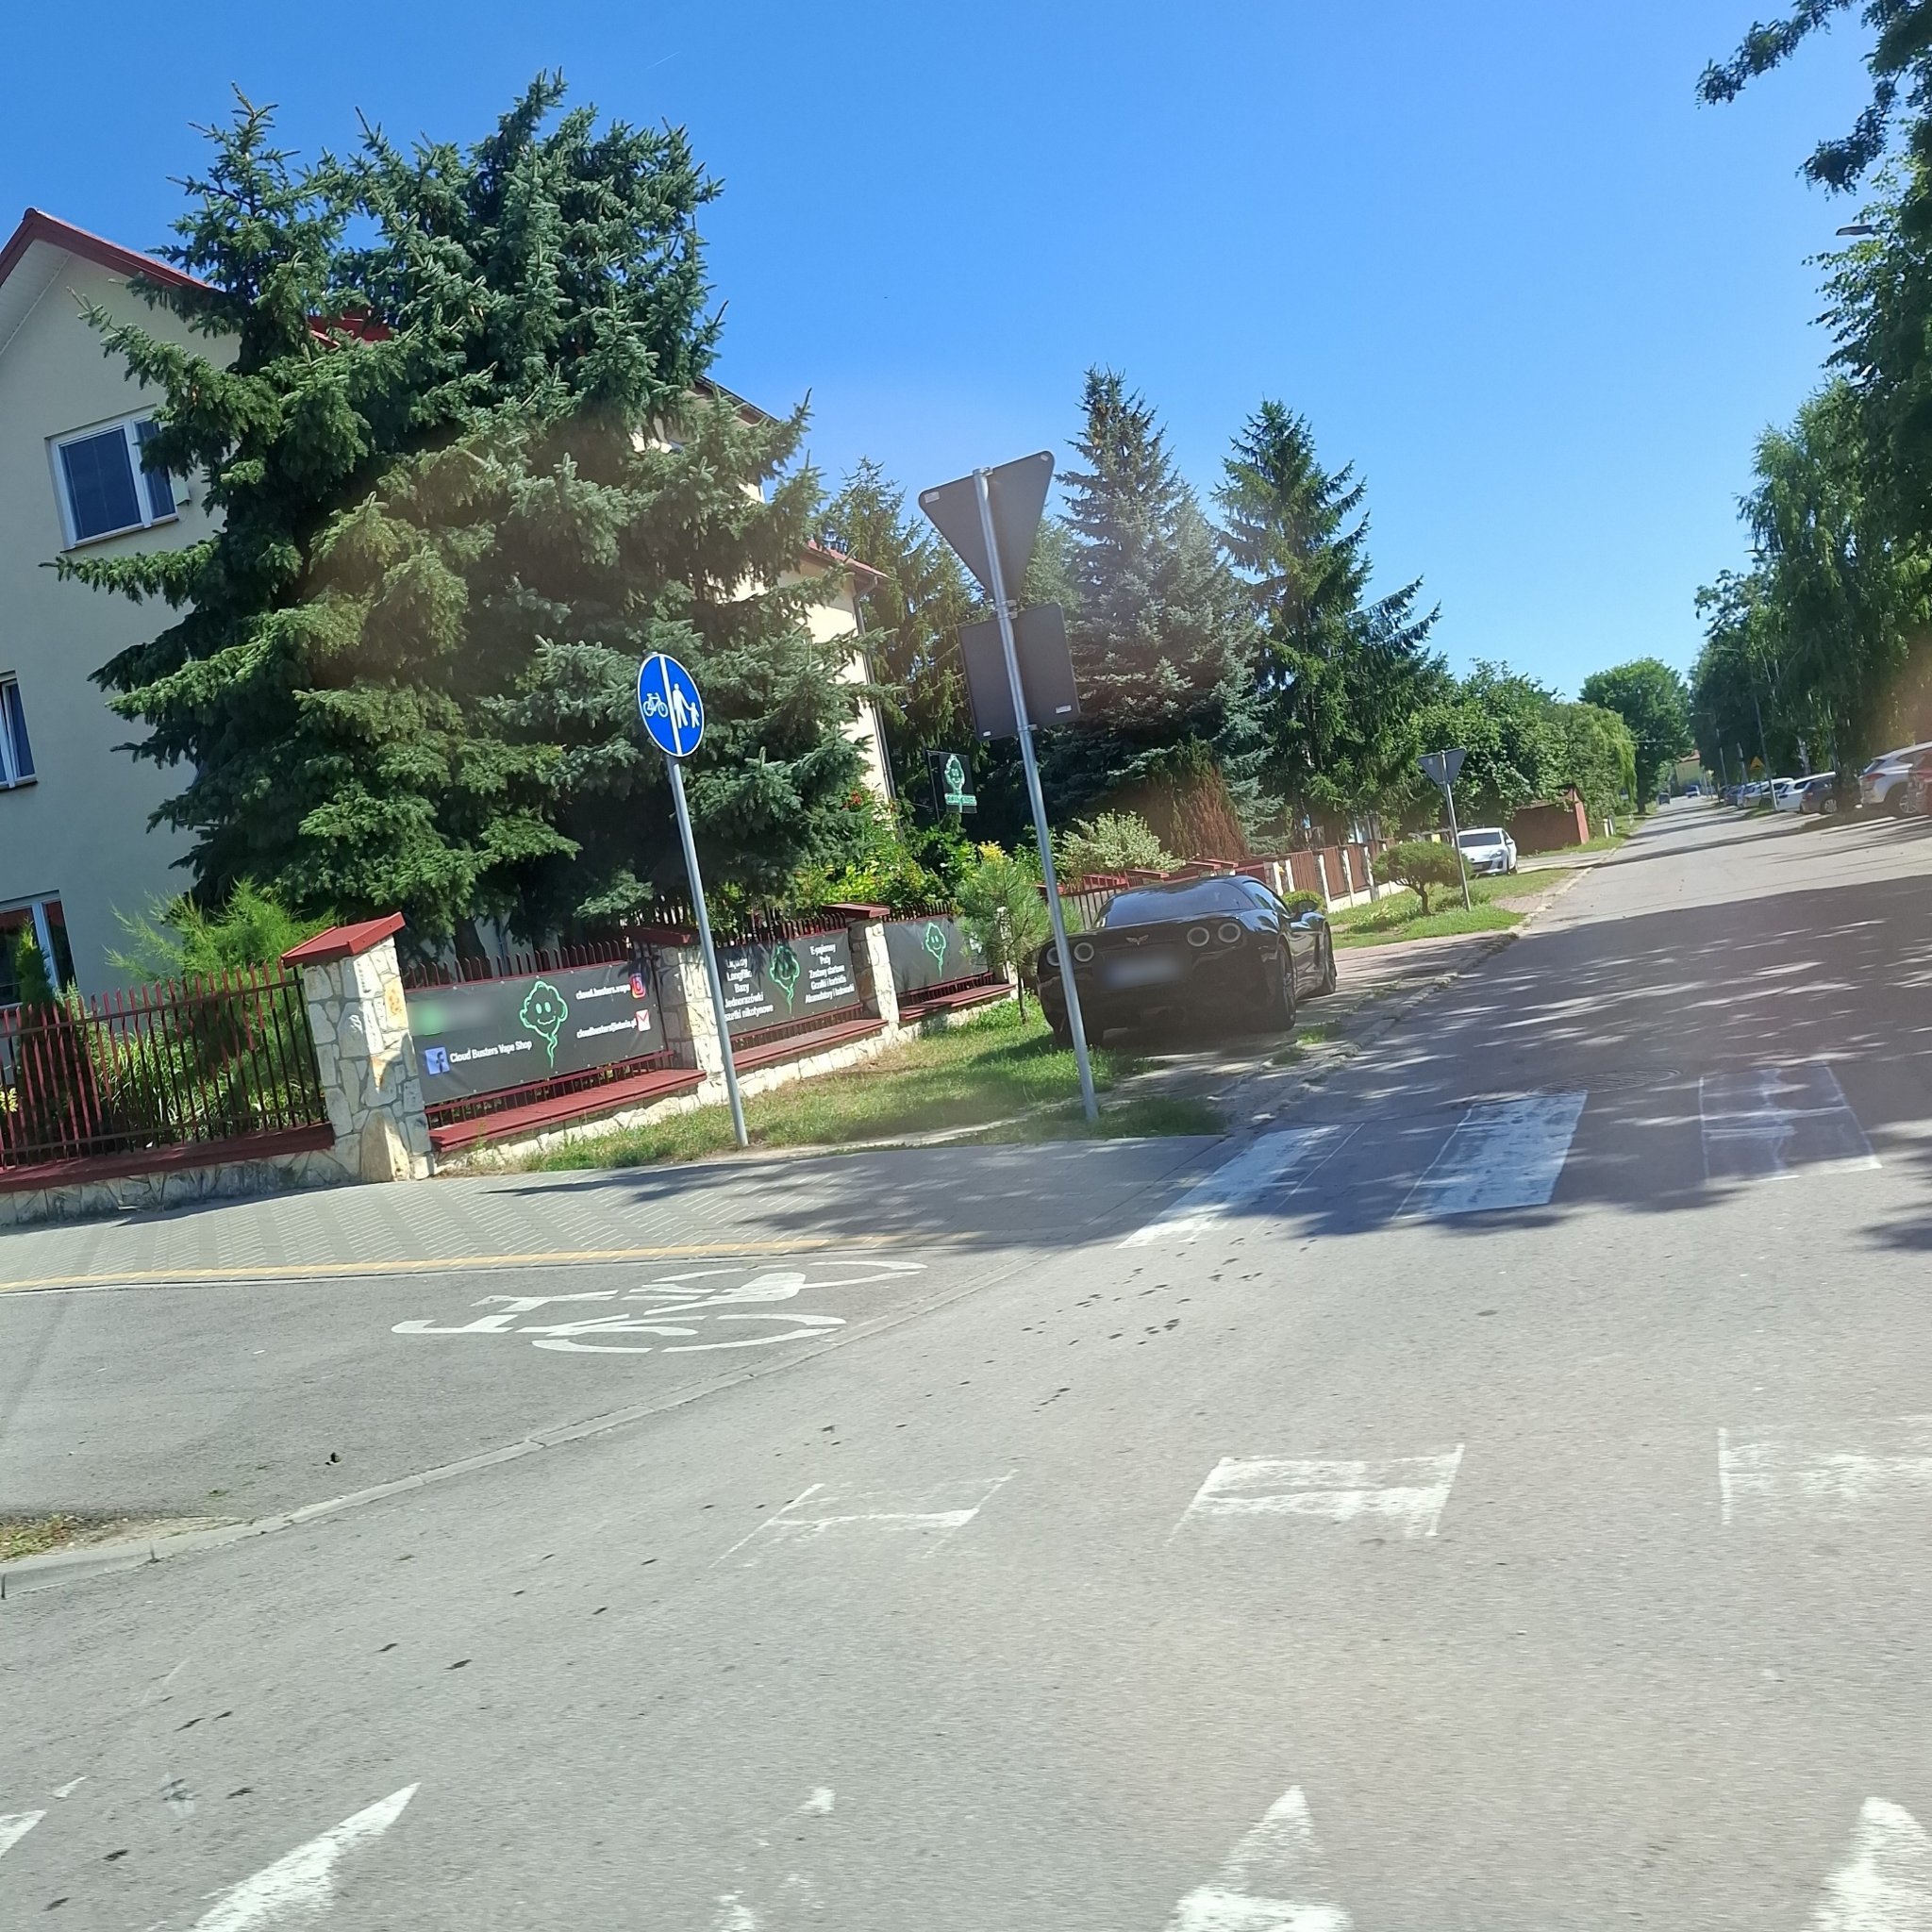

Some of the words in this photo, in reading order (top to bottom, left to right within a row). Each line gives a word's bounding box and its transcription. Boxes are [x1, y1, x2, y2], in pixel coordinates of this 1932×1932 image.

[449, 1048, 472, 1062] Cloud
[472, 1047, 499, 1059] Busters
[498, 1043, 515, 1055] Vape
[515, 1041, 532, 1050] Shop
